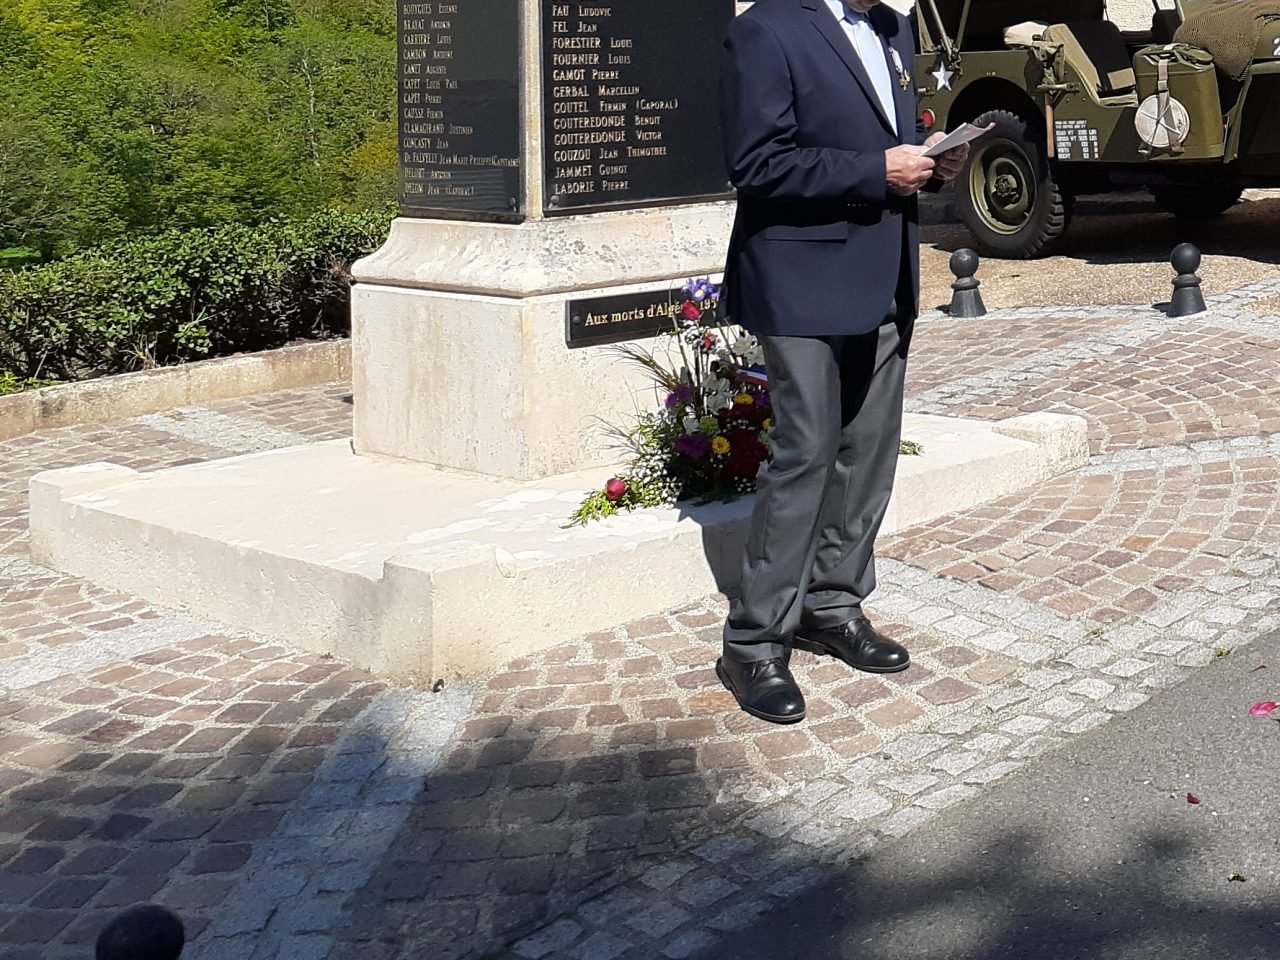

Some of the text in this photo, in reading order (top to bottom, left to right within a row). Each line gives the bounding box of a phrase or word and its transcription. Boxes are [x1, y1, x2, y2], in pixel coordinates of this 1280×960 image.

[552, 5, 569, 16] FAU
[553, 38, 601, 48] FORESTIER
[553, 54, 599, 65] FOURNIER
[585, 313, 608, 326] Aux
[611, 308, 644, 322] morts
